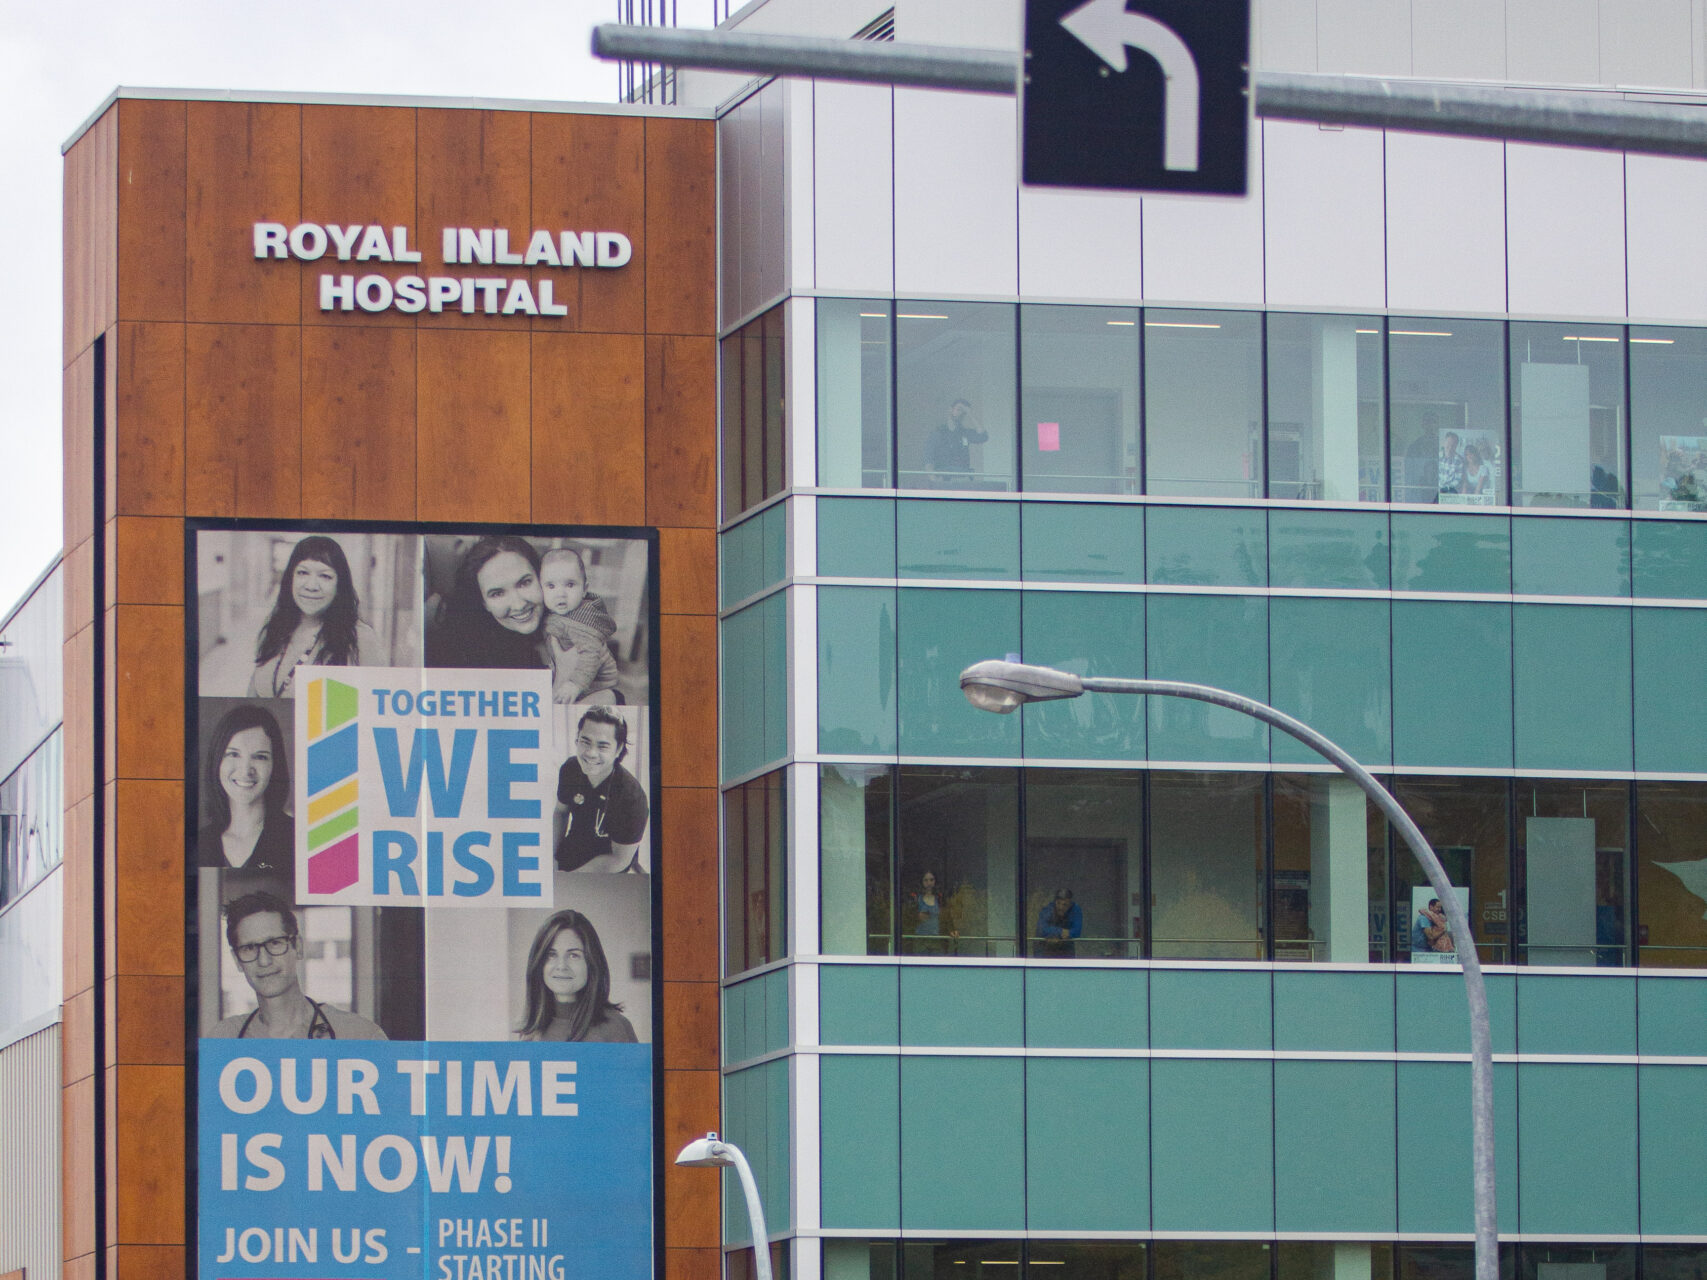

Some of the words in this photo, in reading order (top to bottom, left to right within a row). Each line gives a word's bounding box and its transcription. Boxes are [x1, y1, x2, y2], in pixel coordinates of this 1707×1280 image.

[253, 222, 422, 263] ROYAL
[442, 227, 633, 269] INLAND
[319, 274, 568, 317] HOSPITAL
[372, 688, 540, 718] TOGETHER
[373, 727, 542, 820] WE
[372, 830, 542, 898] RISE
[219, 1057, 381, 1116] OUR
[398, 1059, 579, 1117] TIME
[220, 1132, 285, 1192] IS
[307, 1134, 513, 1193] NOW!
[217, 1227, 318, 1264] JOIN
[332, 1227, 388, 1264] US
[438, 1218, 522, 1248] PHASE
[532, 1219, 548, 1248] II
